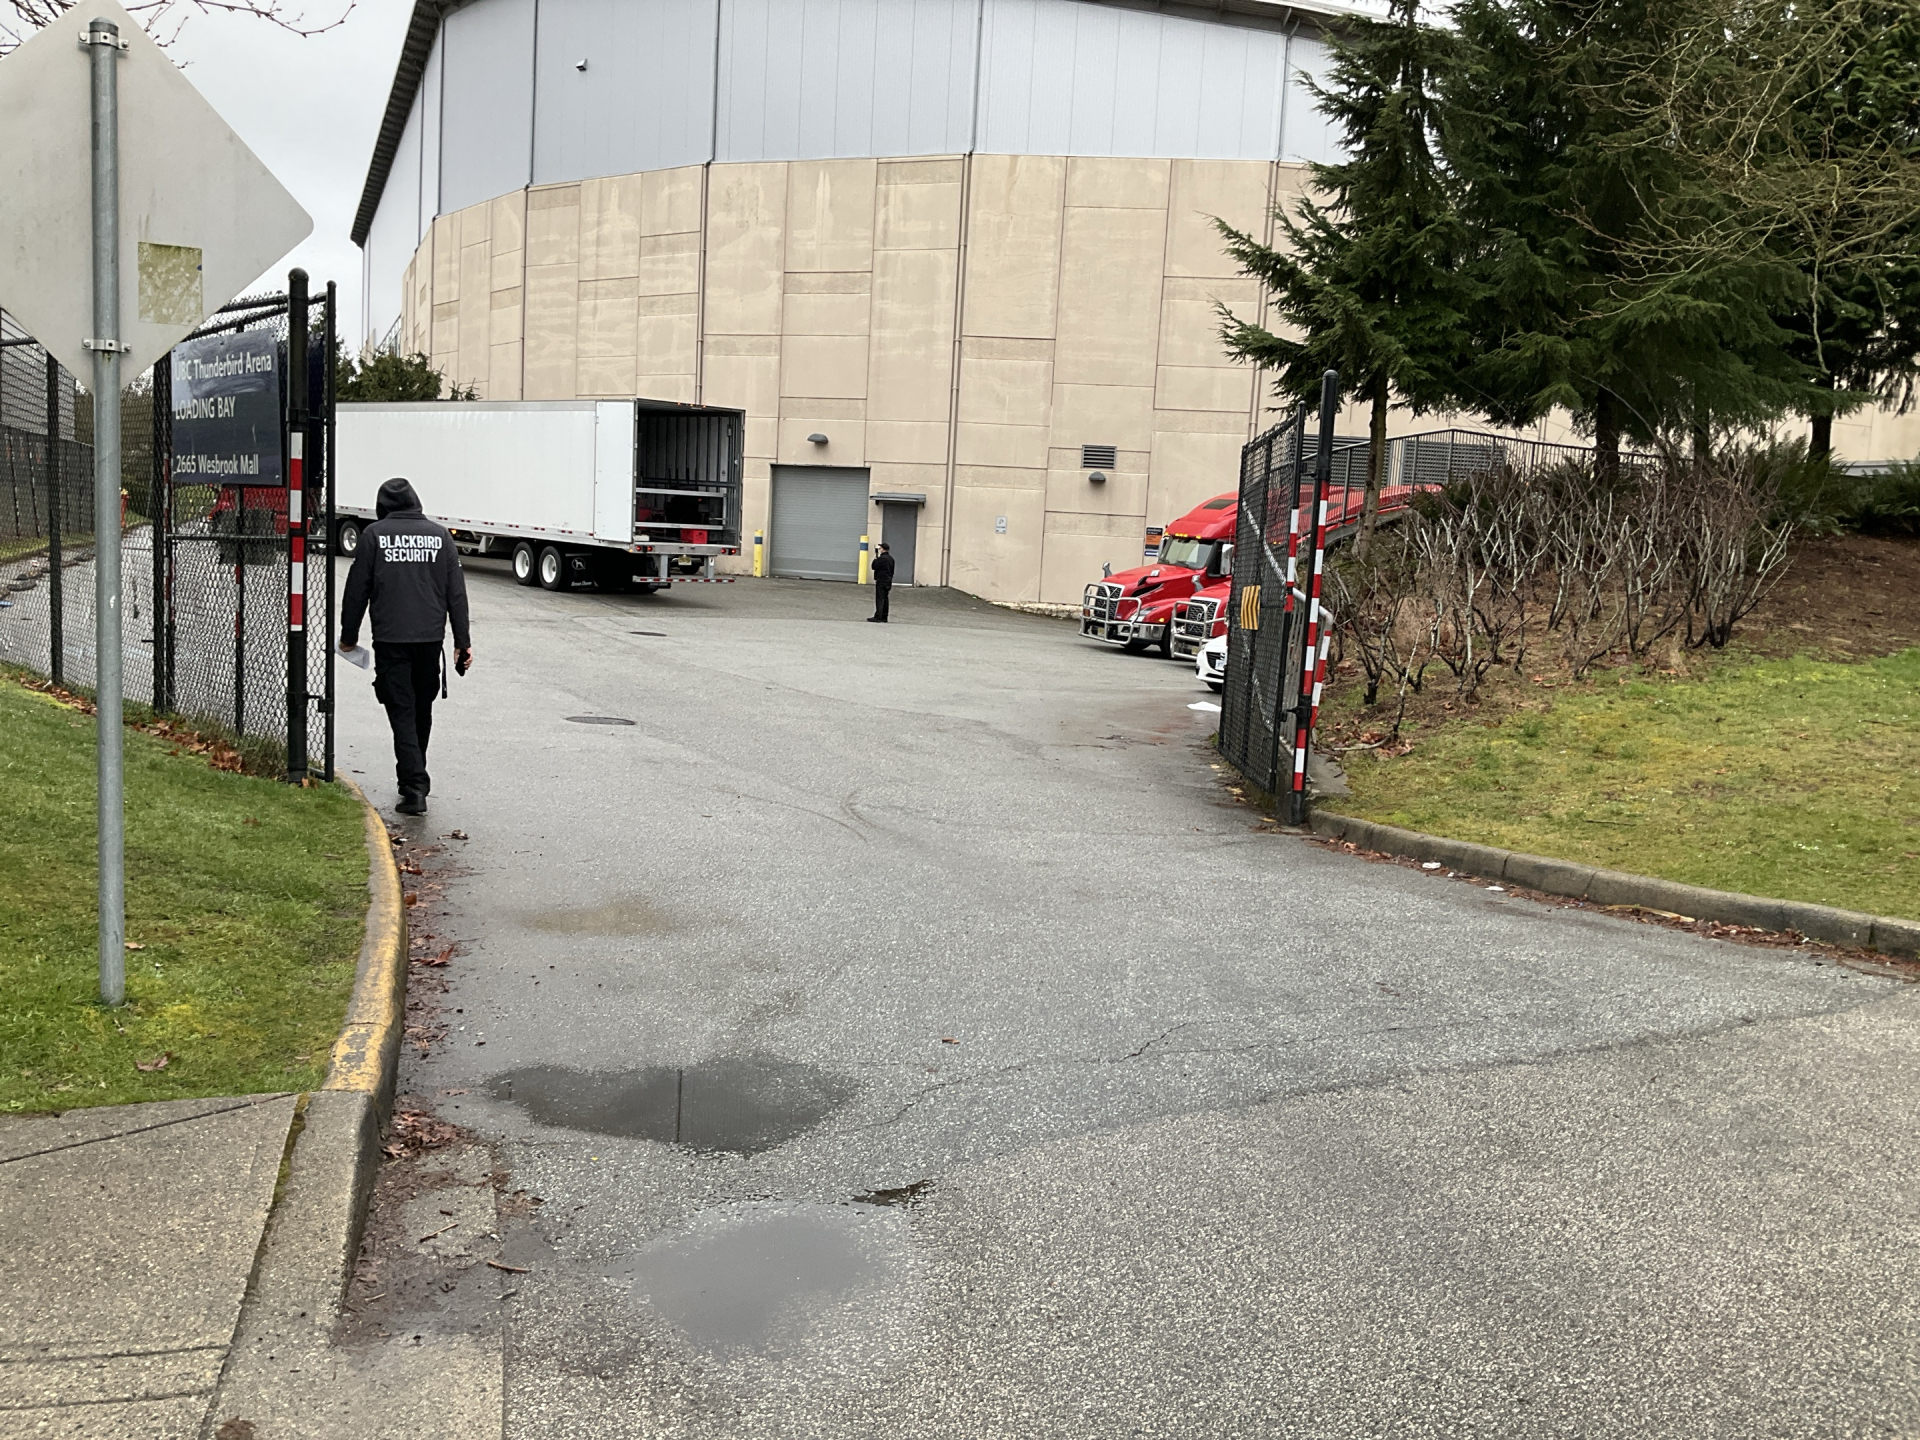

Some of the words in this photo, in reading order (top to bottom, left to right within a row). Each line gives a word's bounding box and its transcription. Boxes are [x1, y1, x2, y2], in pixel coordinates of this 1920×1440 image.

[174, 360, 192, 380] UBC
[193, 352, 243, 379] Thunderbird
[245, 351, 272, 373] Arena
[175, 397, 215, 420] LOADING
[217, 396, 236, 418] BAY
[176, 455, 196, 473] 2665
[197, 454, 239, 474] Wesbrook
[240, 454, 259, 474] Mall
[379, 535, 442, 549] BLACKBIRD
[385, 549, 438, 562] SECURITY
